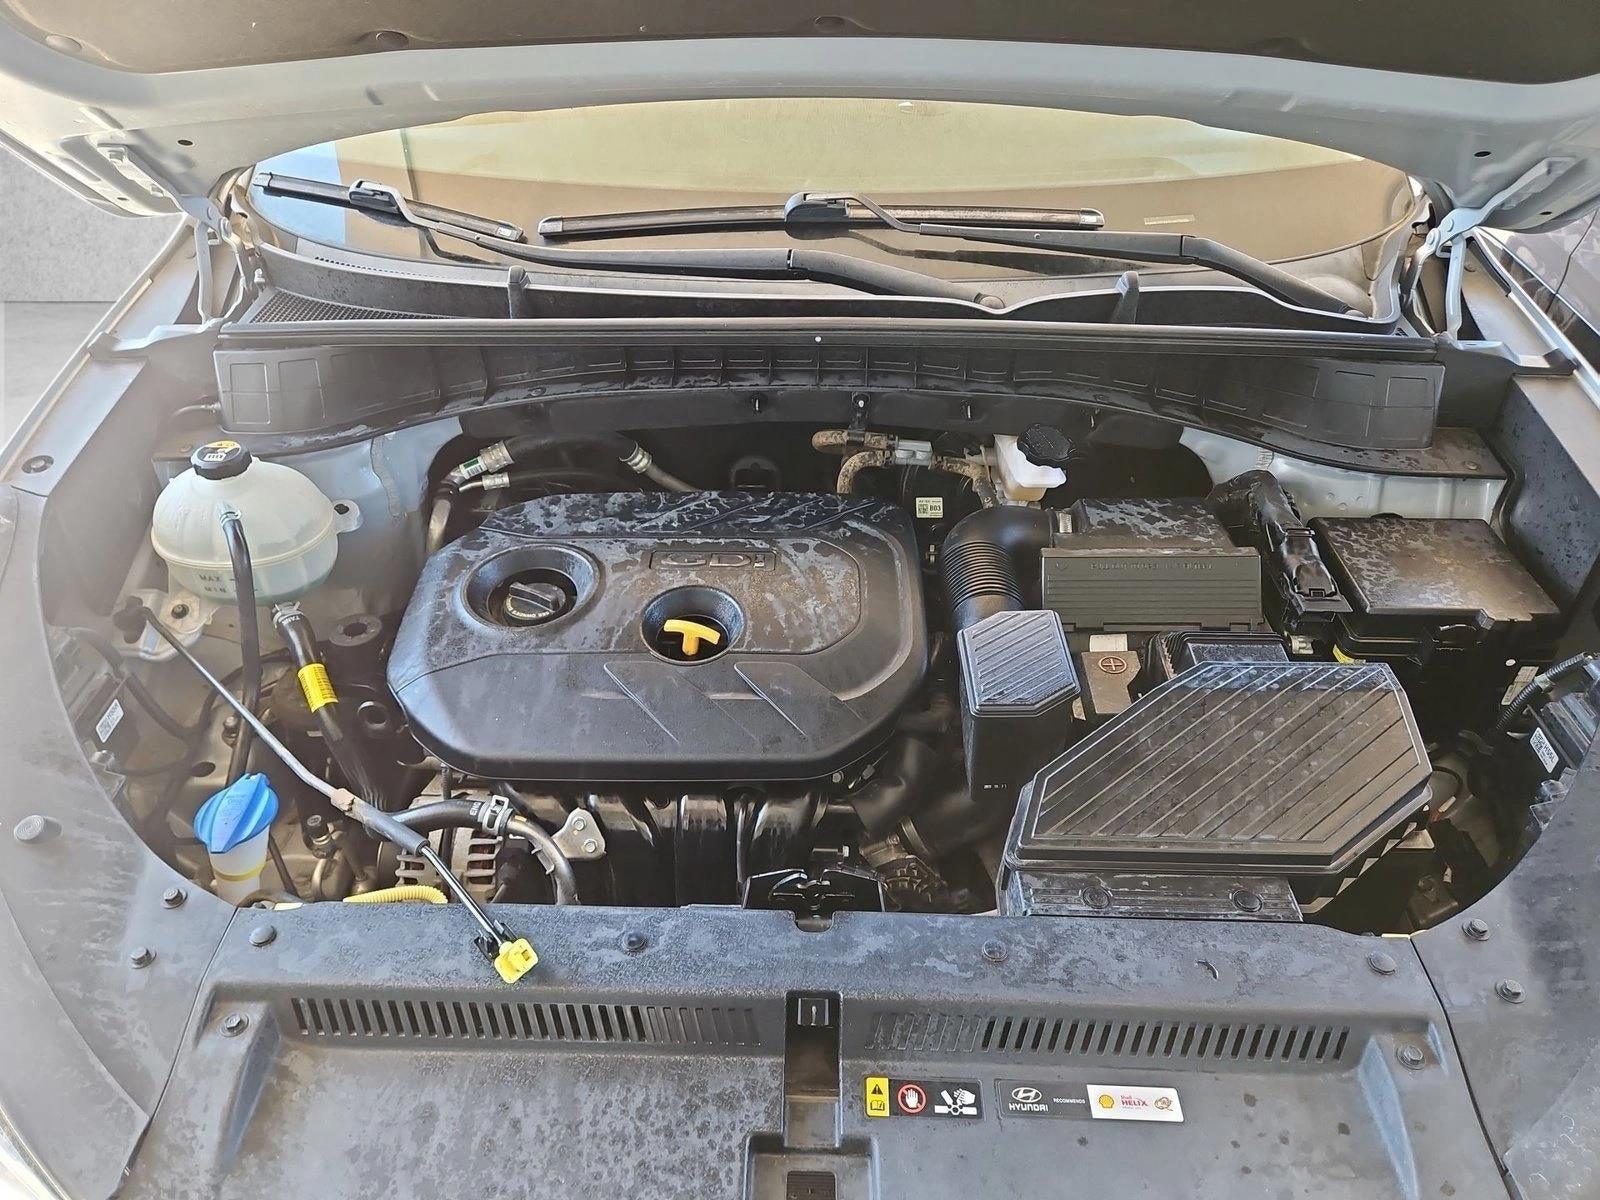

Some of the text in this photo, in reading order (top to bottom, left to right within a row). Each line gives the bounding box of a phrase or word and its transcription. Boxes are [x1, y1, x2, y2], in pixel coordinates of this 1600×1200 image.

[199, 574, 221, 582] MAX
[1121, 1099, 1148, 1107] HELIX
[1008, 1103, 1049, 1112] HYUNDAI
